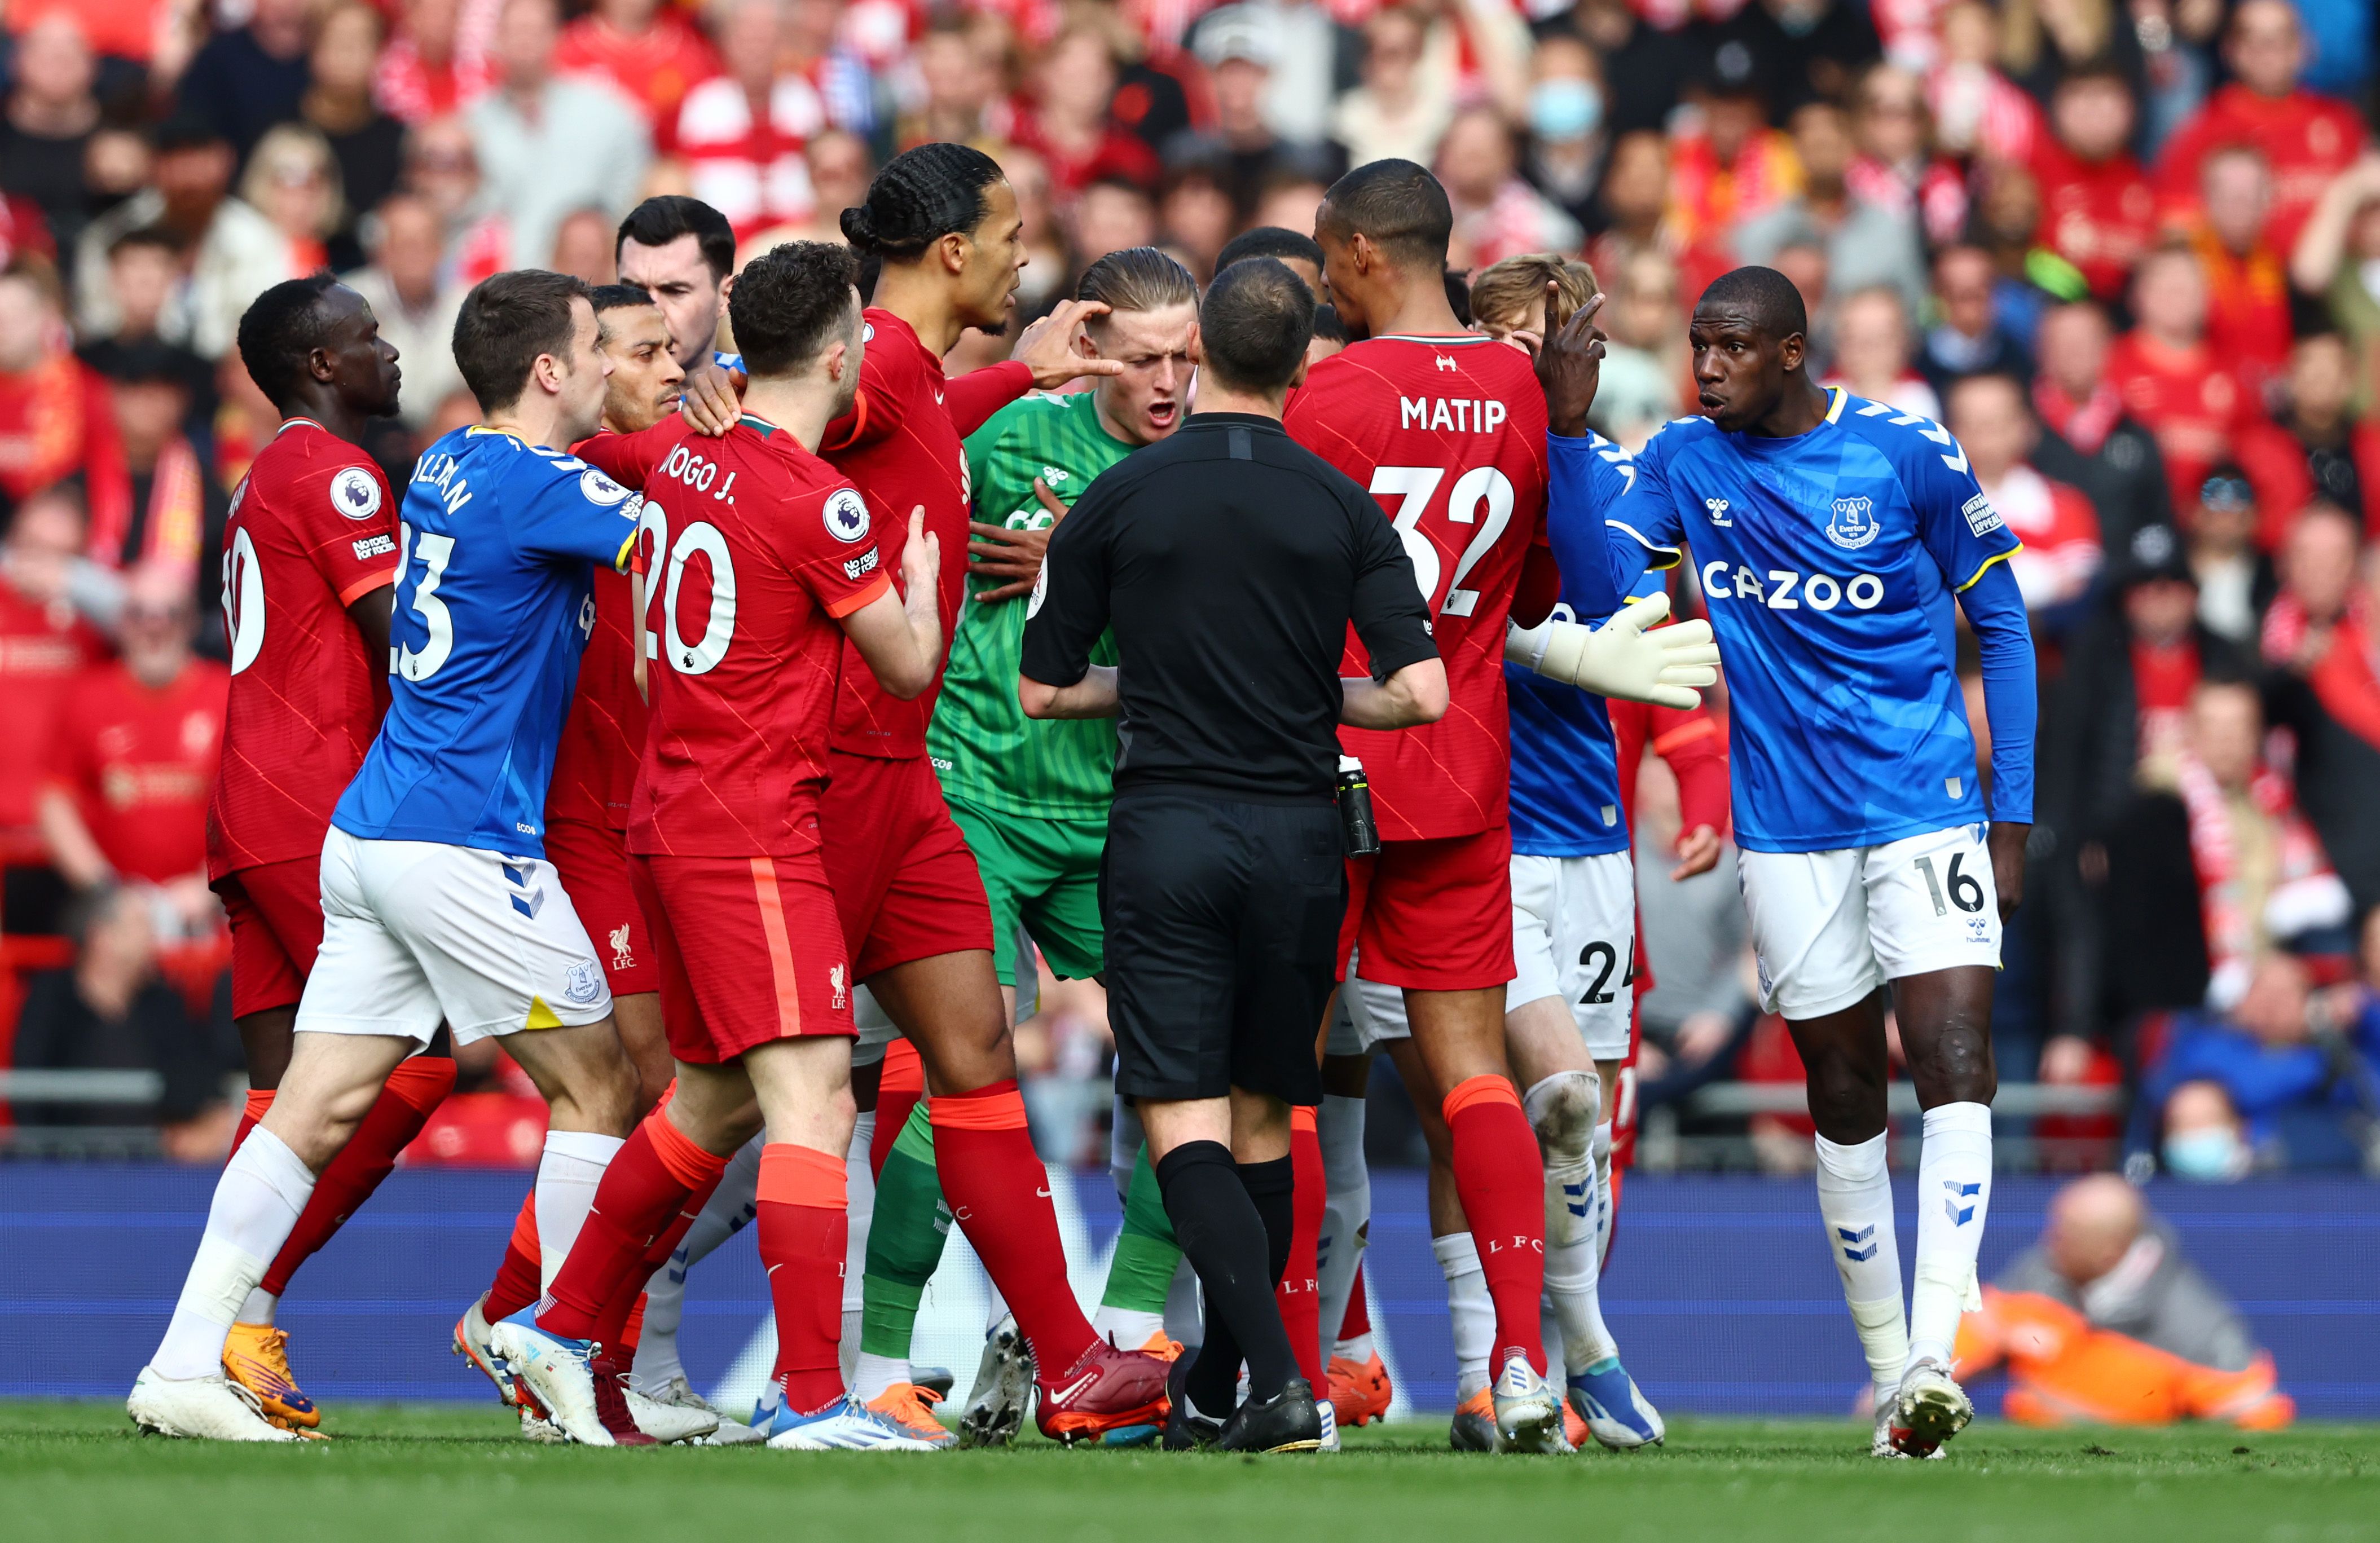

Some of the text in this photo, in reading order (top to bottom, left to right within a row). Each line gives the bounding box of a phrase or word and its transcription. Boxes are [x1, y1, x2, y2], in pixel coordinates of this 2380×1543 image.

[1400, 396, 1506, 433] MATIP
[714, 471, 736, 505] J.
[1839, 524, 1867, 533] Everton
[1974, 513, 2002, 534] APPEAL
[352, 540, 370, 551] No
[1368, 466, 1515, 617] 32
[356, 546, 373, 560] for
[844, 559, 860, 571] No
[846, 565, 861, 580] for
[638, 500, 737, 675] 20
[1702, 561, 1885, 611] CAZOO
[1423, 619, 1432, 631] No
[516, 822, 536, 835] ECO8
[1914, 852, 1984, 917] 16
[612, 958, 637, 970] L.F.C.
[575, 983, 593, 993] Everton
[803, 1405, 824, 1417] NIKE
